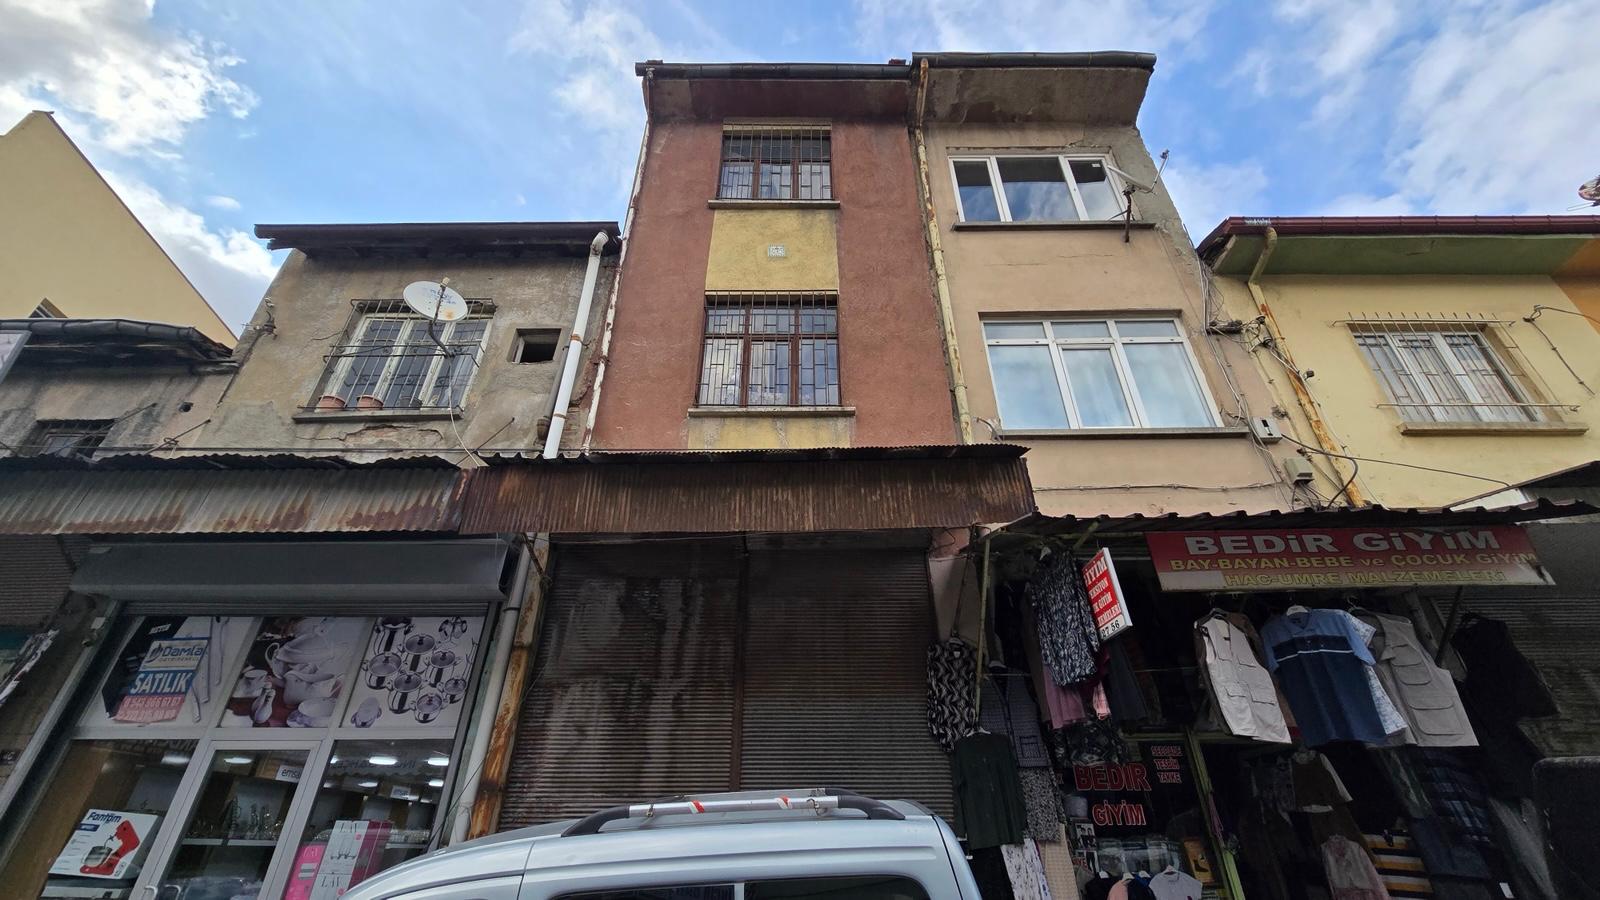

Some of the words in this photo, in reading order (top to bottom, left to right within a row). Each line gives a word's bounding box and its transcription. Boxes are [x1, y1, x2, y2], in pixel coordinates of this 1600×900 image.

[1169, 555, 1354, 571] BAY-BAYAN-BEBE
[1360, 557, 1385, 566] ve
[1391, 553, 1470, 567] ÇOCUK
[1083, 556, 1108, 587] İYİM
[1224, 572, 1344, 587] HAC-UMRE
[1111, 619, 1120, 632] 56
[163, 645, 204, 657] Damla
[130, 672, 193, 694] SATILIK
[1092, 800, 1147, 826] GİYİM
